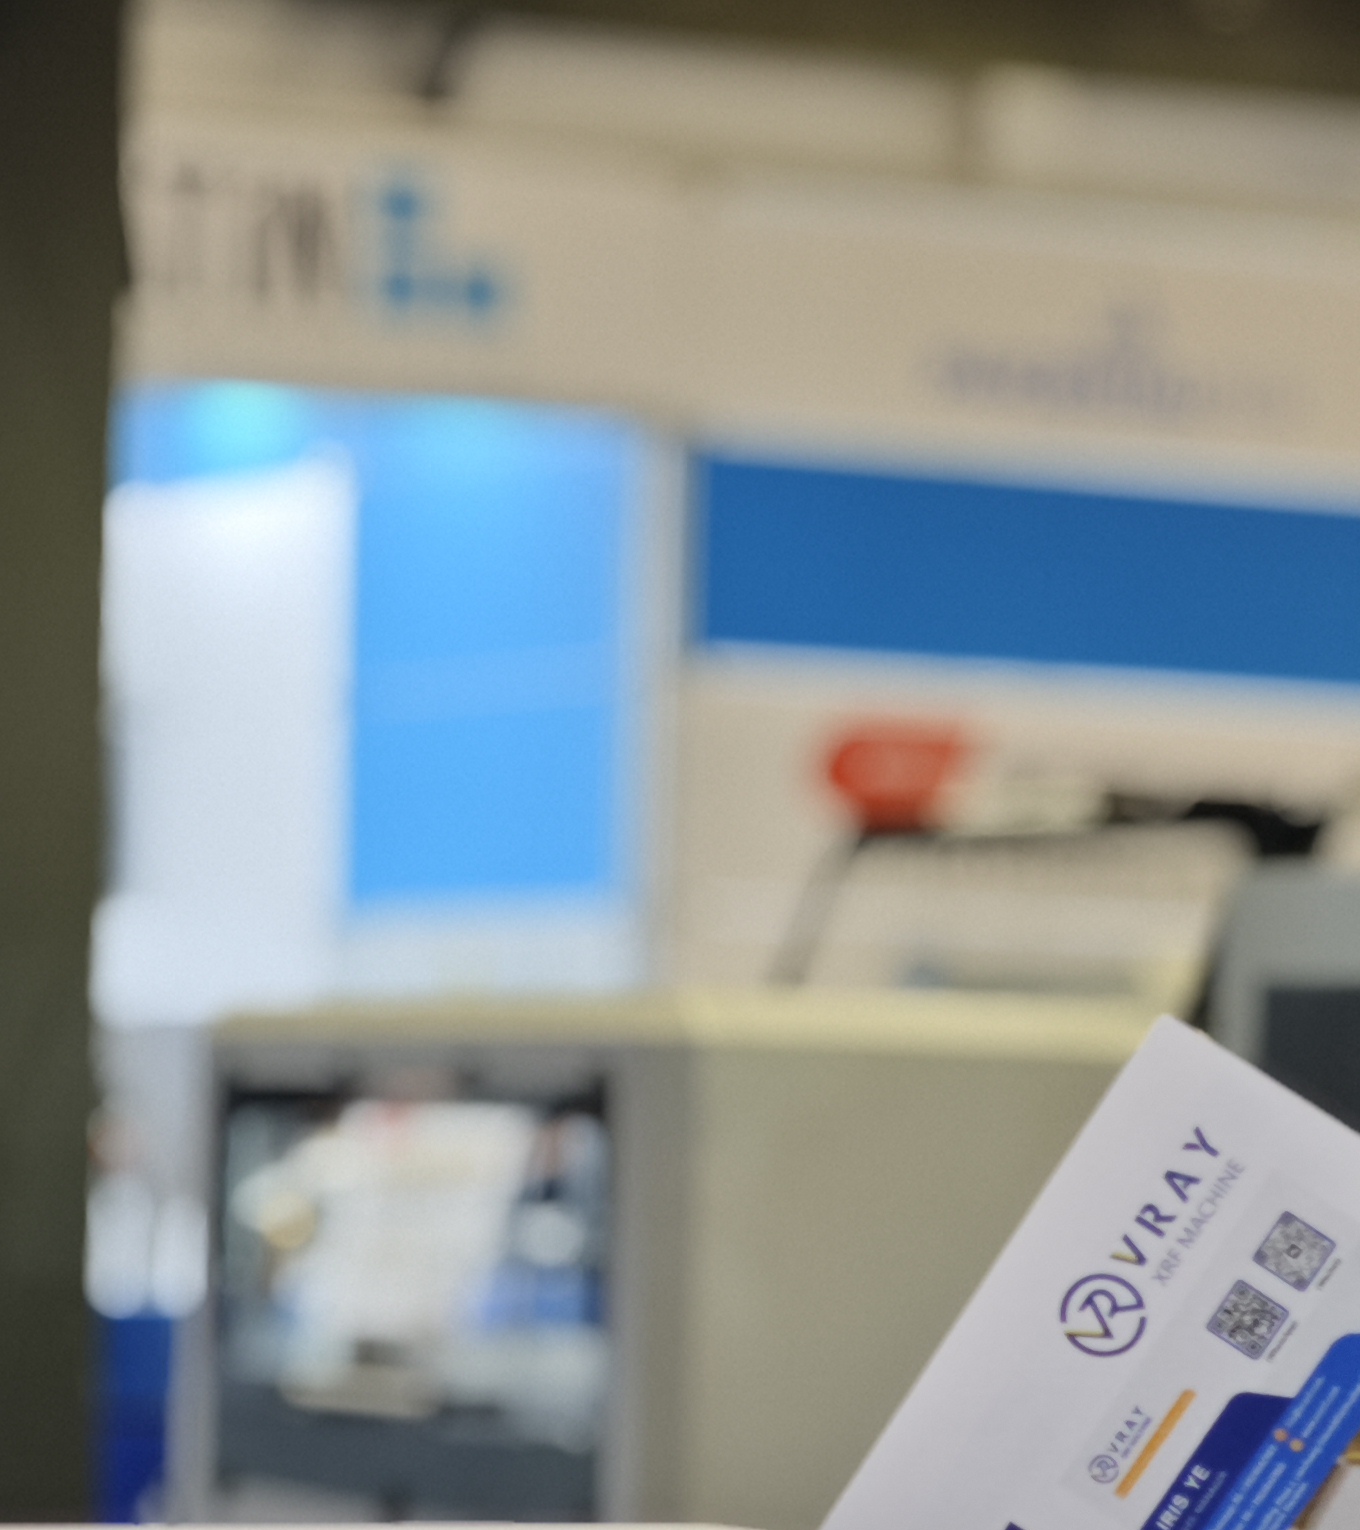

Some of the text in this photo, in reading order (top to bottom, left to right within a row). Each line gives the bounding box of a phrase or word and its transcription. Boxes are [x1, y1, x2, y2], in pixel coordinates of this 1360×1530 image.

[1110, 1126, 1220, 1267] VRAY
[1151, 1158, 1246, 1287] XRF MACHINE
[1109, 1405, 1143, 1453] VRAY
[1183, 1464, 1211, 1490] YE
